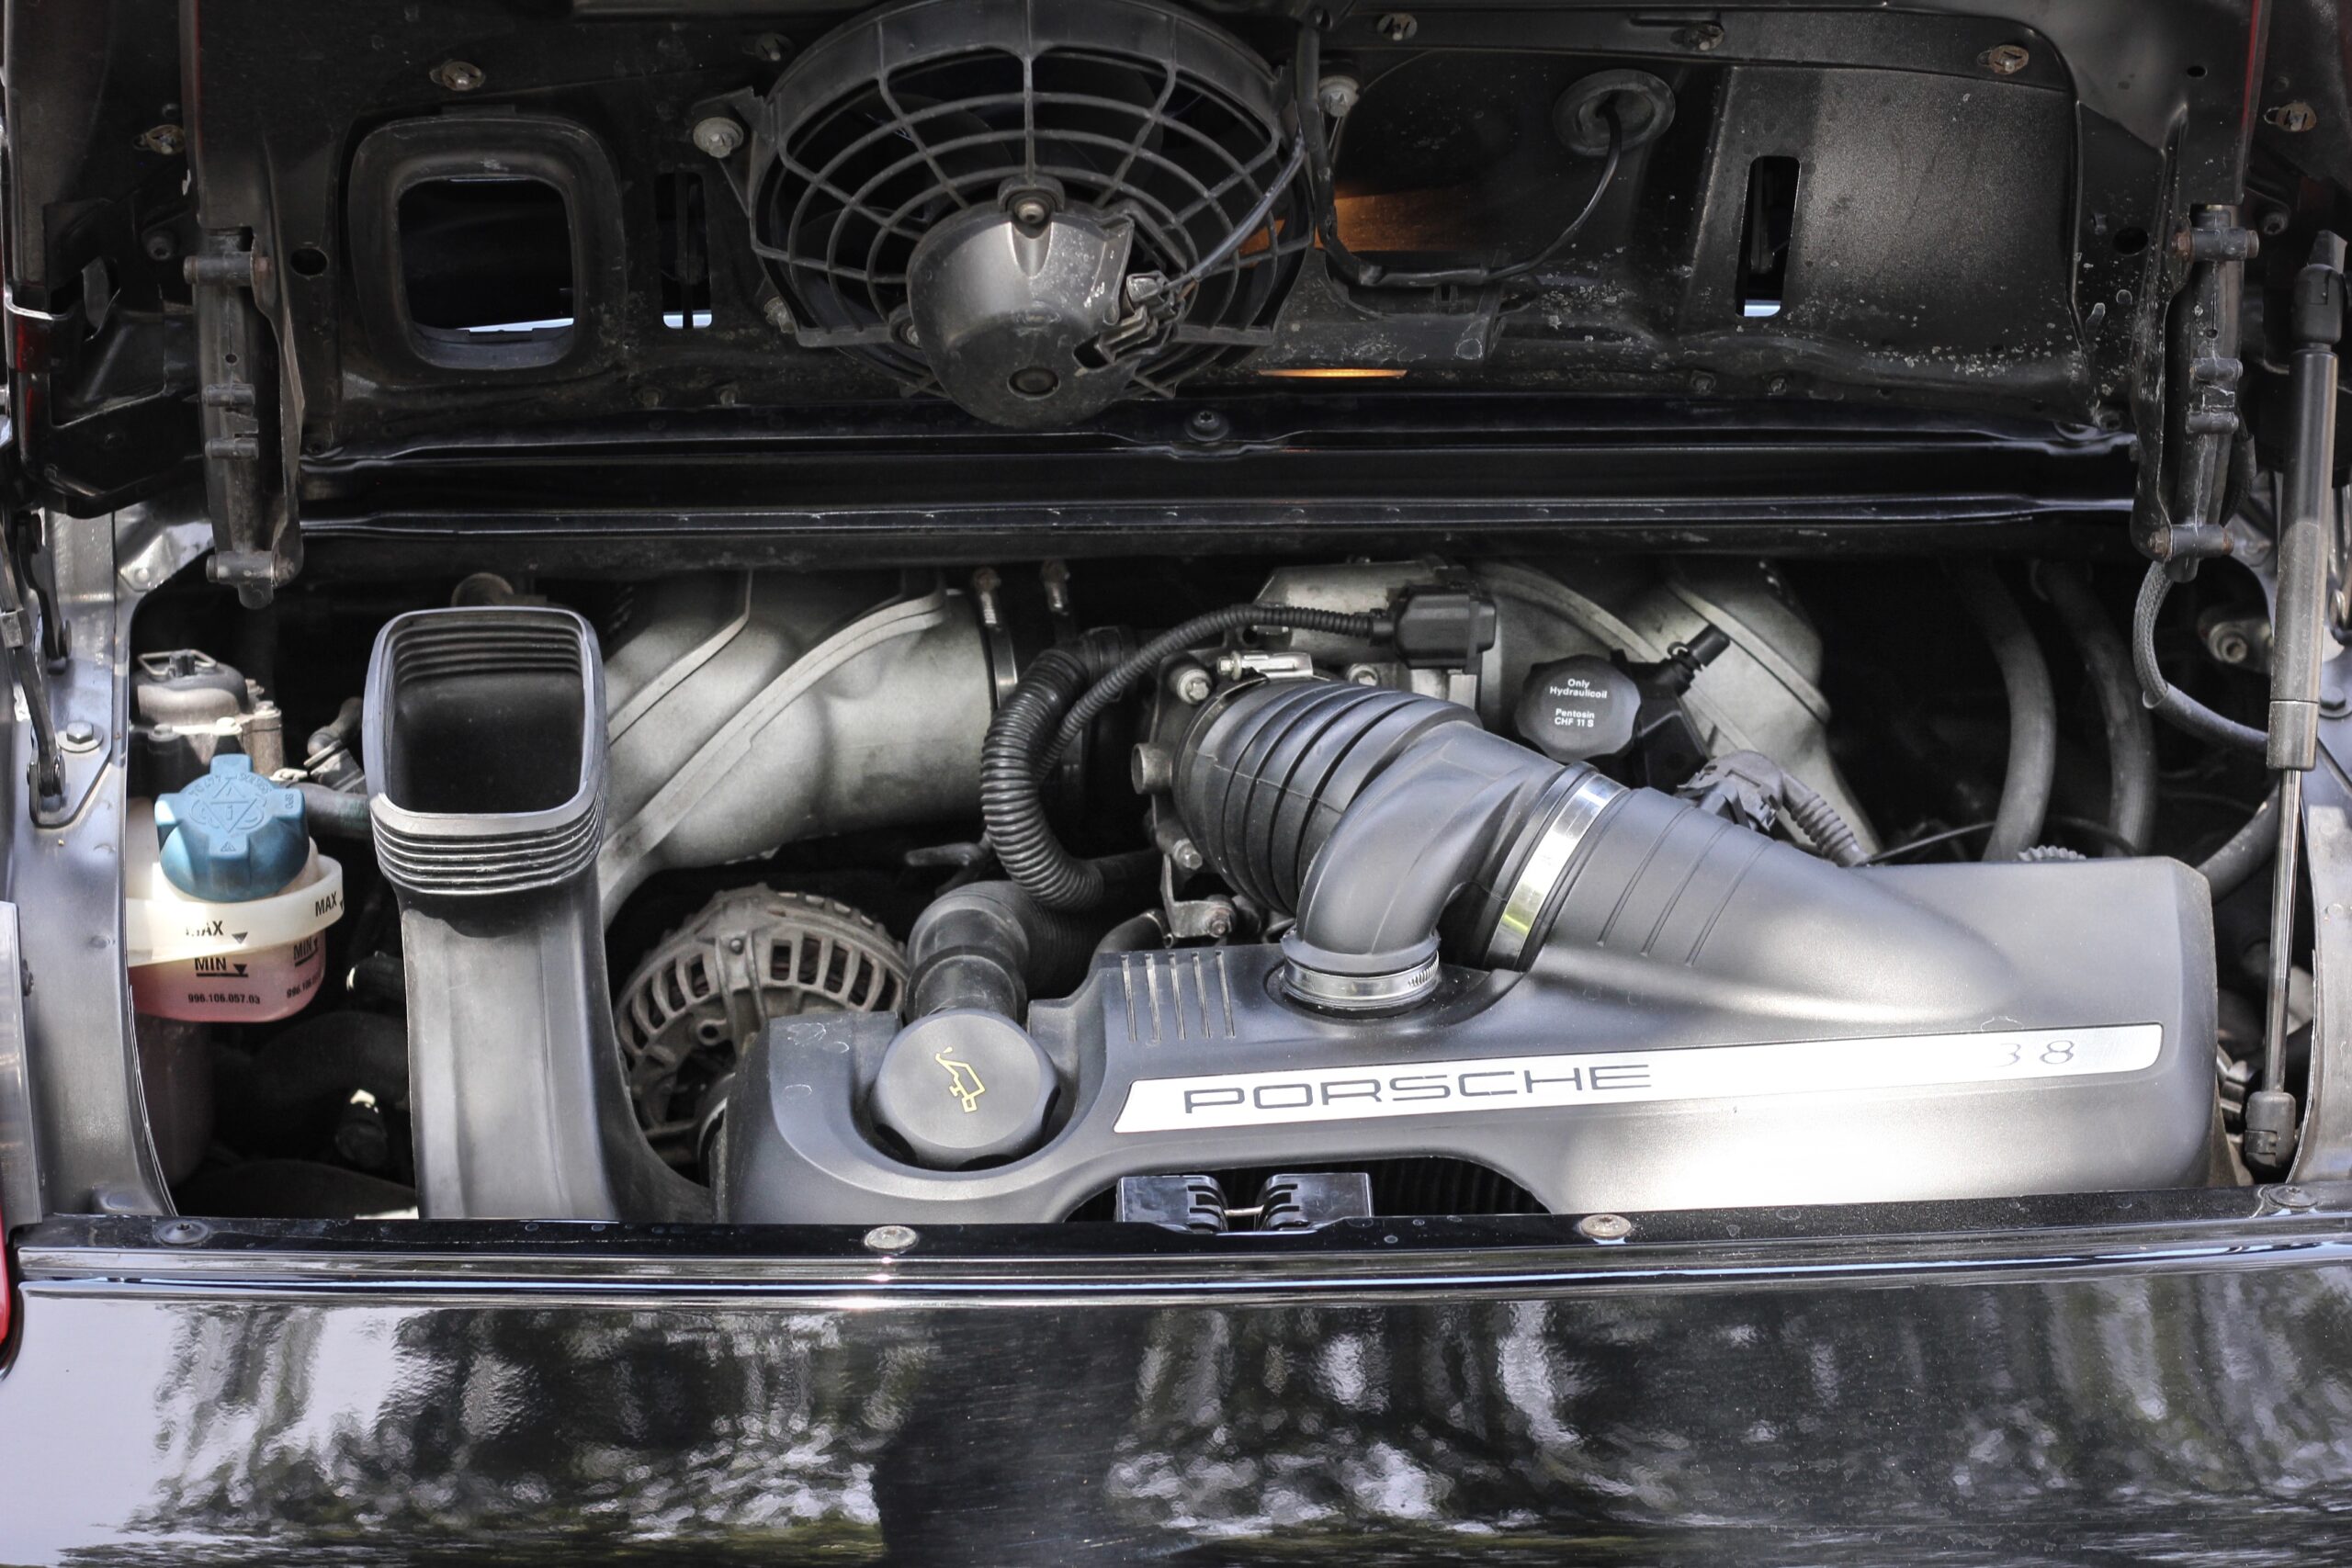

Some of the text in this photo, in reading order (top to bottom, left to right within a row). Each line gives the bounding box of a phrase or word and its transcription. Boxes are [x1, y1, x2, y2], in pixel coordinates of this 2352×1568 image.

[1567, 679, 1590, 688] Only
[1550, 686, 1608, 698] Hydraulicoil
[1555, 708, 1595, 718] Pentosin
[1555, 717, 1574, 726] CHF
[1588, 719, 1594, 728] S
[315, 891, 337, 917] MAX
[186, 920, 224, 937] AX
[293, 937, 312, 960] MIN
[194, 957, 228, 972] MIN
[187, 993, 262, 1005] 996.106.057.03
[1184, 1064, 1653, 1114] PORSCHE
